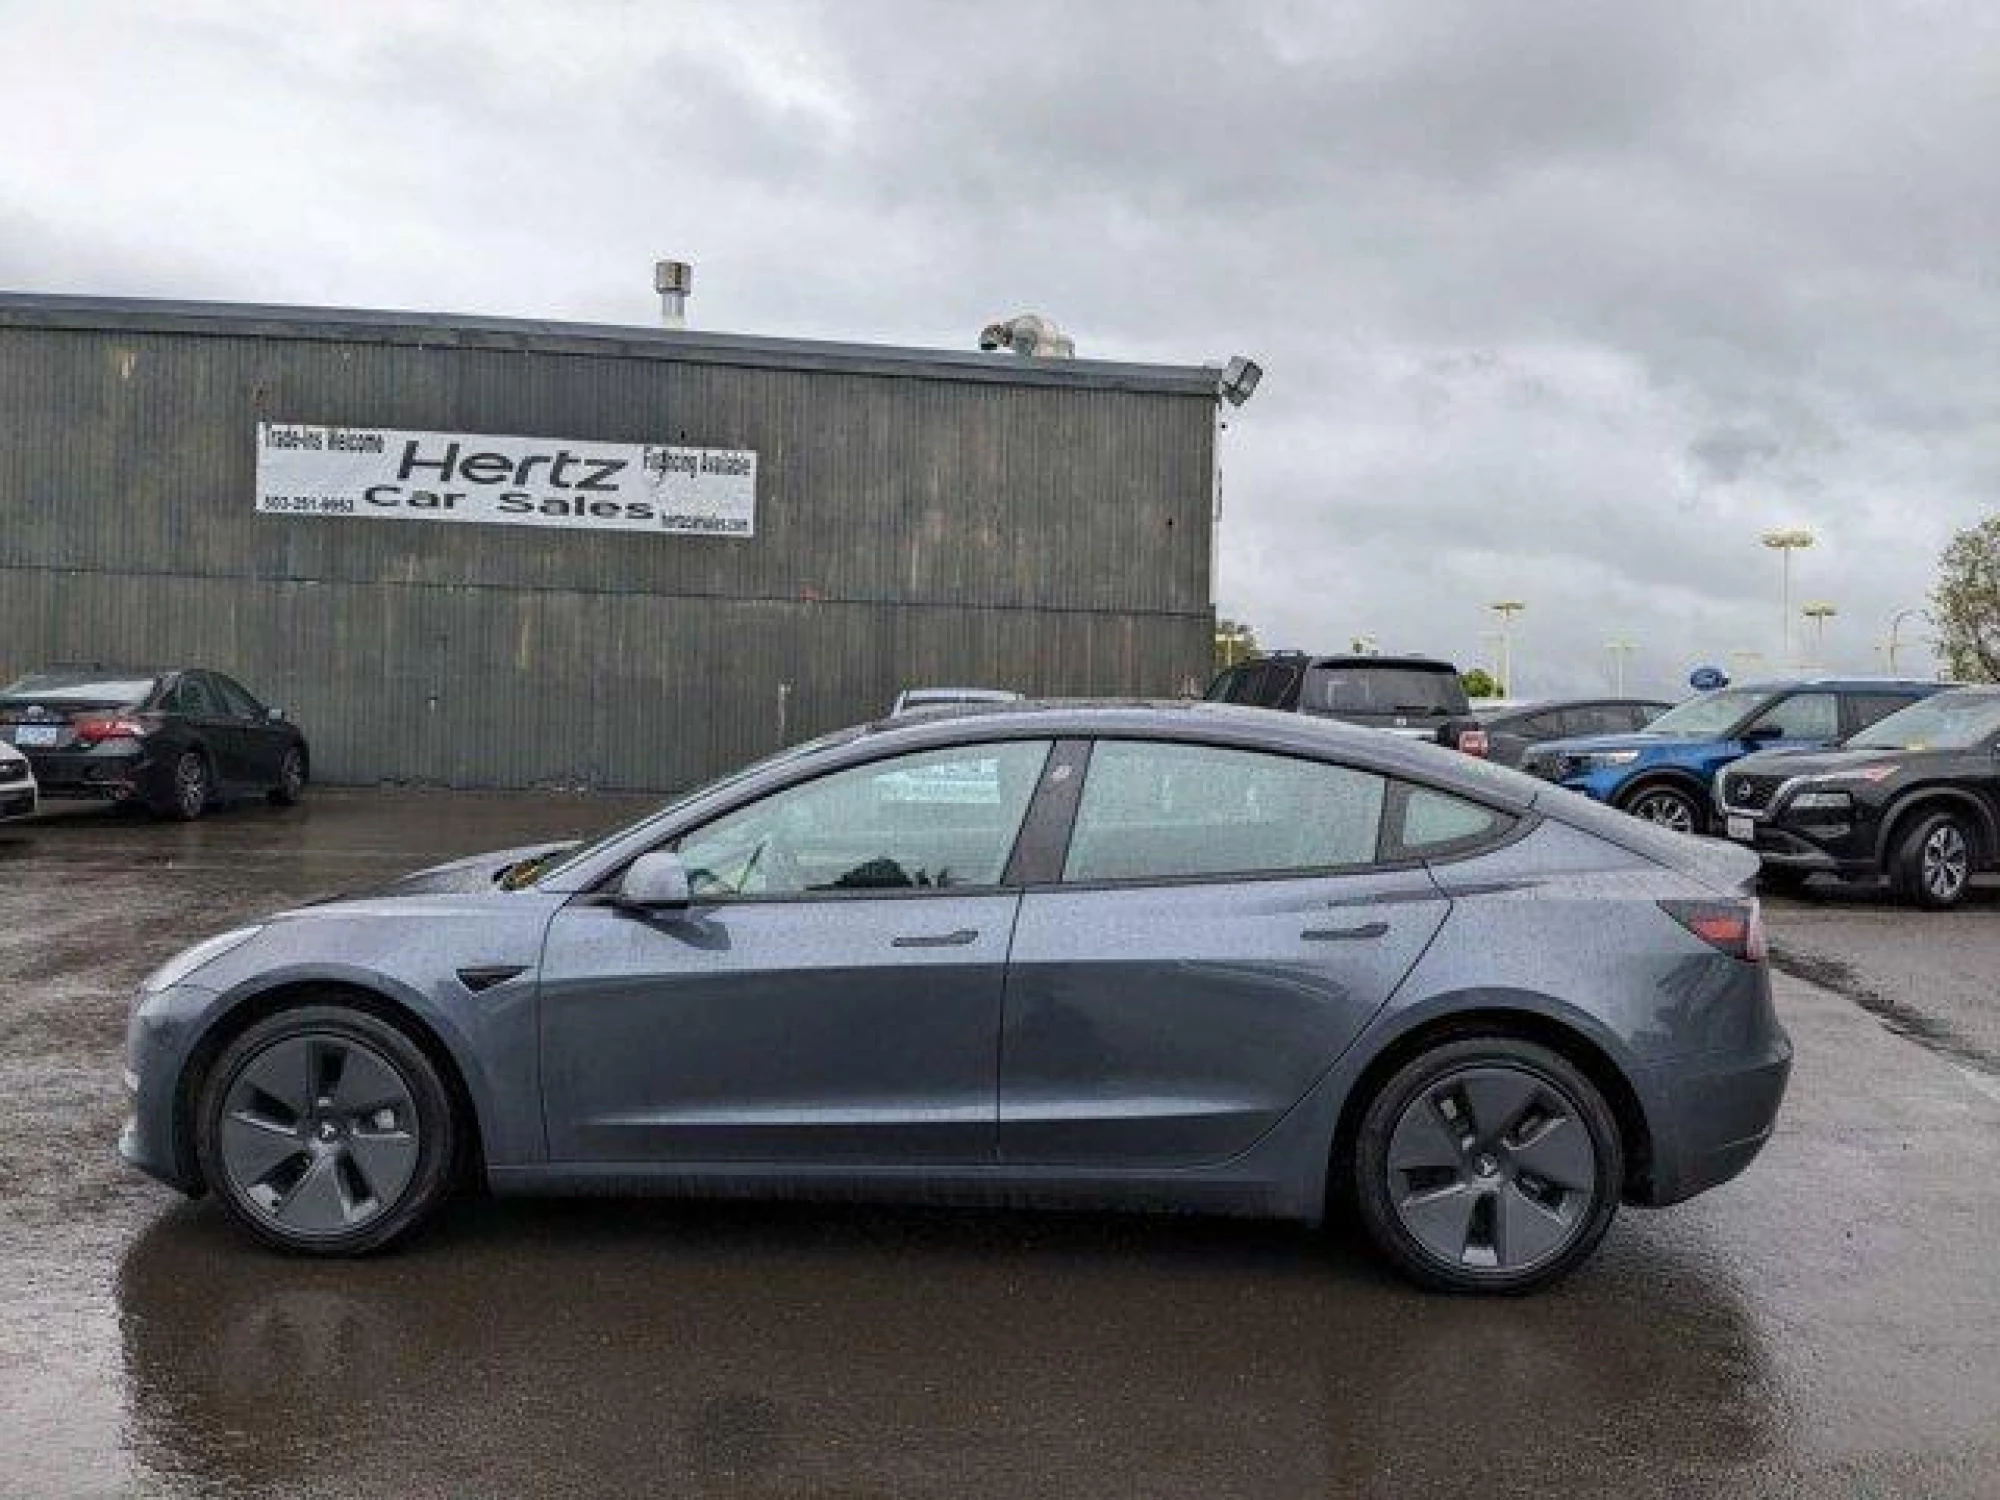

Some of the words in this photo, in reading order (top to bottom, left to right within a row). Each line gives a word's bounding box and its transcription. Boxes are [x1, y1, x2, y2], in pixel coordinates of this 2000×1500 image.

[397, 440, 628, 491] Hertz
[363, 484, 466, 509] Car
[497, 492, 654, 519] Sales
